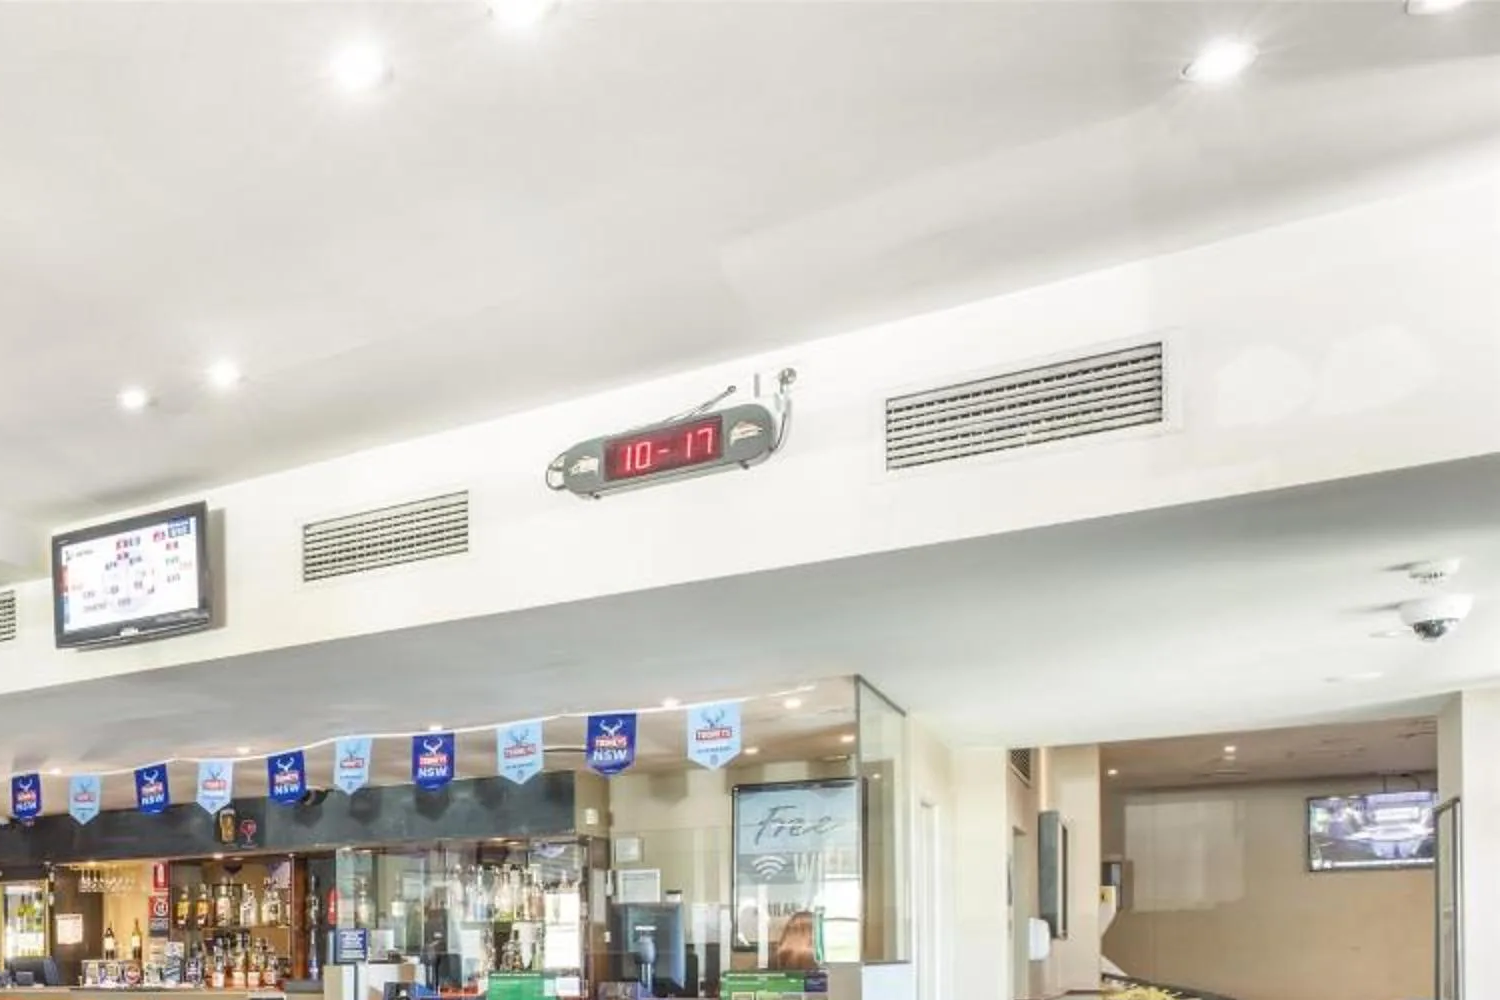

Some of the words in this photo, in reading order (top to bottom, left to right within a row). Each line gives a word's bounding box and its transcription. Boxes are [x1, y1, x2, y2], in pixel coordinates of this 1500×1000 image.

[622, 426, 715, 472] 10-17
[593, 748, 628, 761] NSW
[417, 766, 449, 778] NSW
[274, 783, 300, 795] NSW
[754, 804, 844, 846] Free
